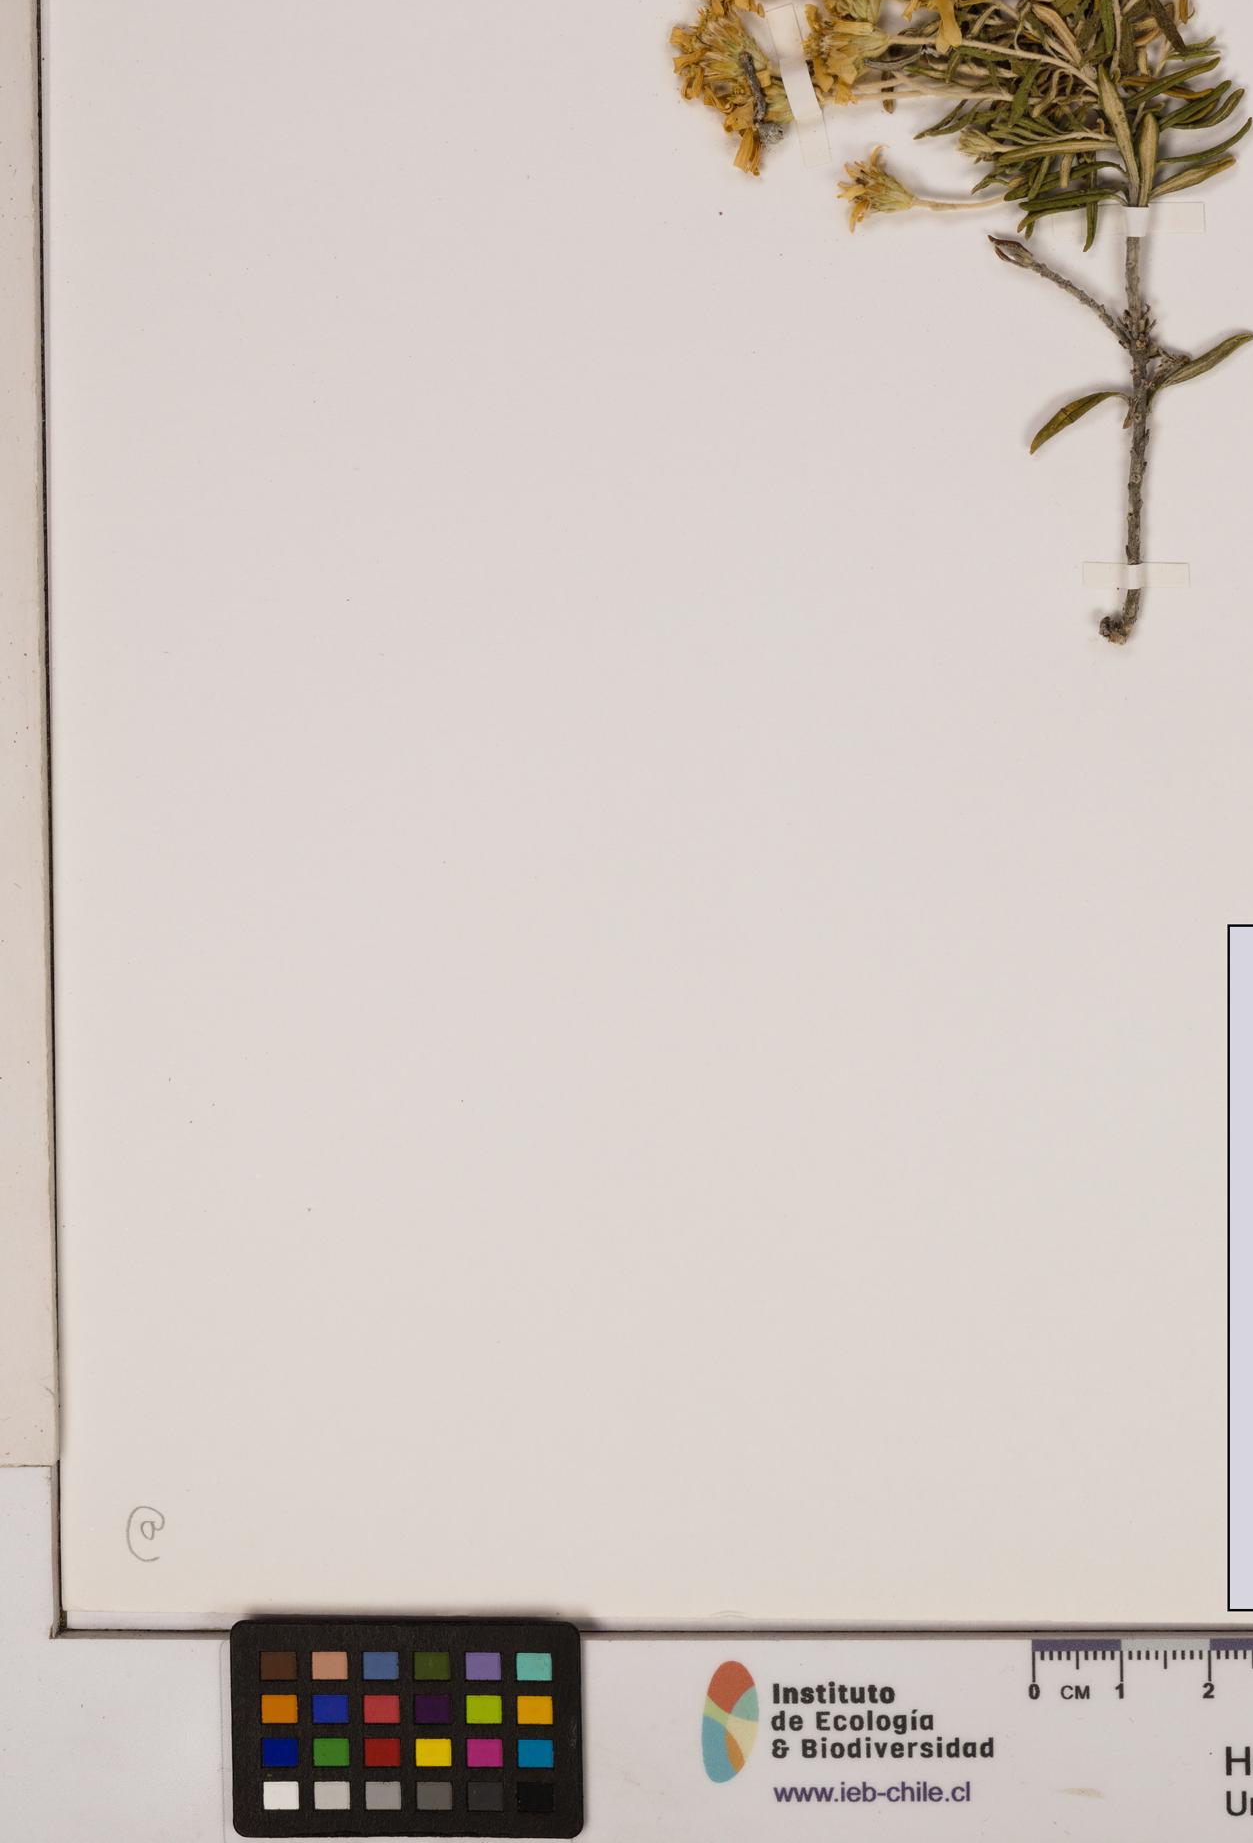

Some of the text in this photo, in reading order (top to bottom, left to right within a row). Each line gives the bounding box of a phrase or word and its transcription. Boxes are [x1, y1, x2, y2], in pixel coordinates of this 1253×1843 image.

[772, 1680, 896, 1705] Instituto
[1028, 1682, 1041, 1701] 0
[1060, 1684, 1091, 1700] CM
[1114, 1682, 1125, 1700] 1
[1202, 1681, 1215, 1700] 2
[770, 1708, 934, 1736] de Ecología
[771, 1736, 995, 1759] & Biodiversidad
[772, 1780, 971, 1803] www.ieb-chile.cl
